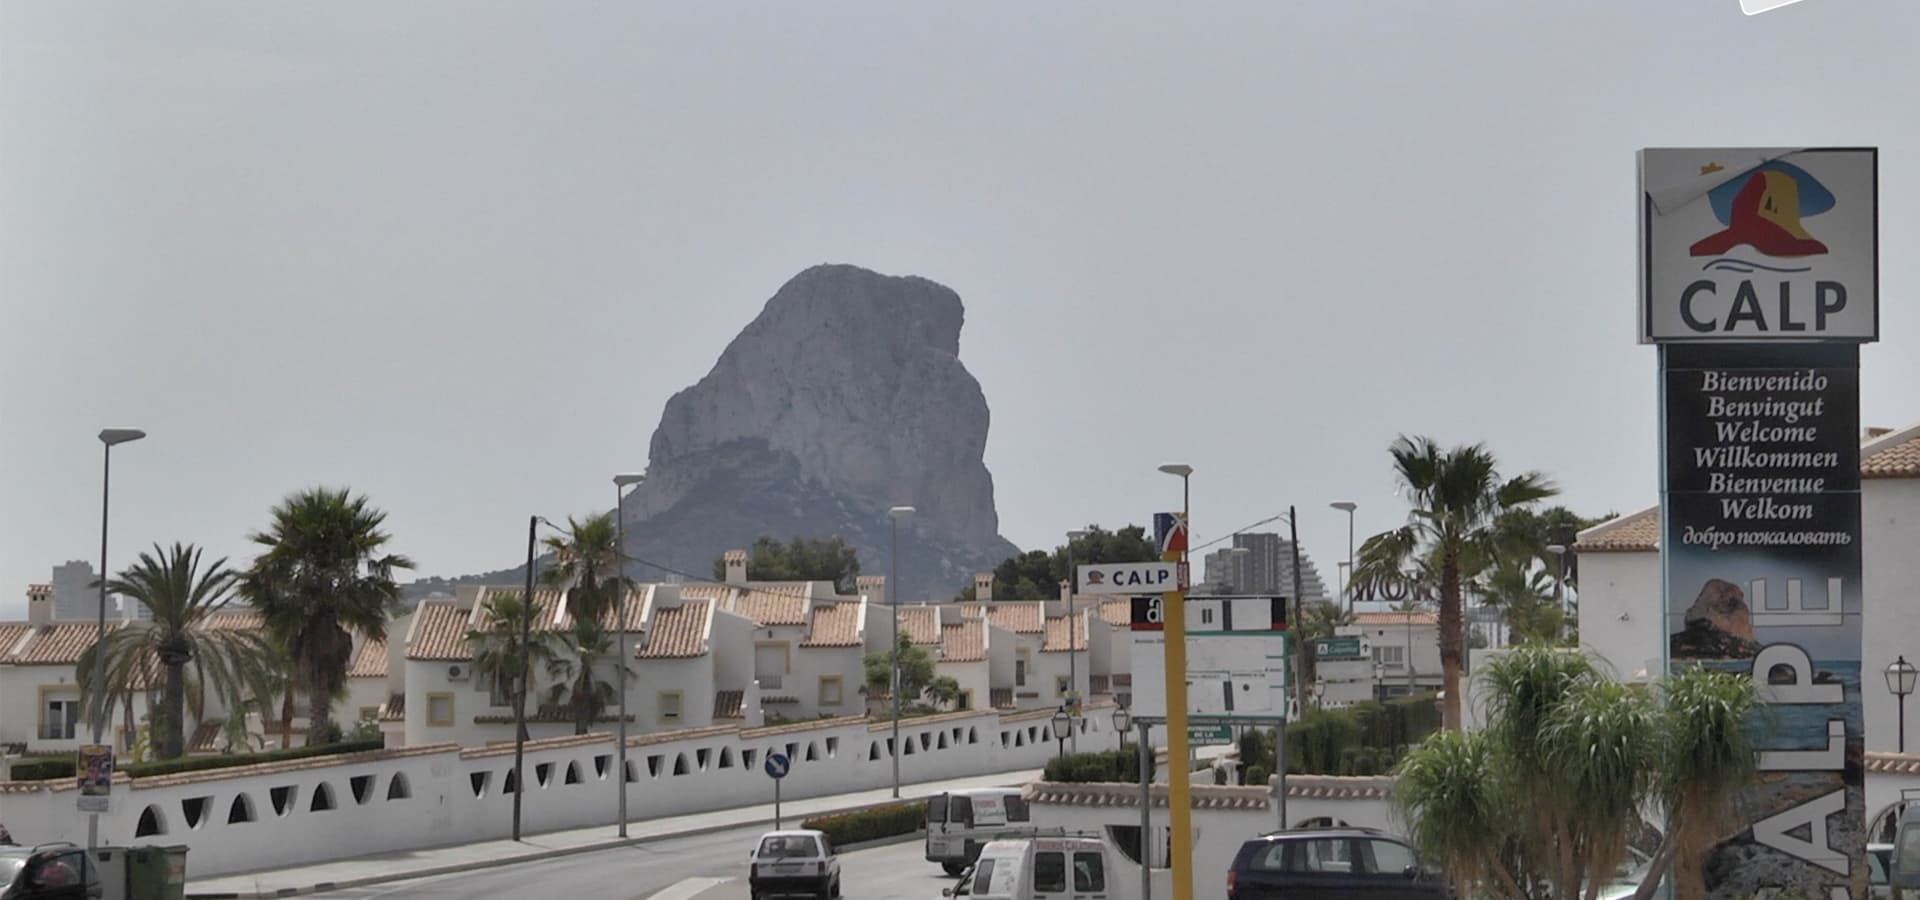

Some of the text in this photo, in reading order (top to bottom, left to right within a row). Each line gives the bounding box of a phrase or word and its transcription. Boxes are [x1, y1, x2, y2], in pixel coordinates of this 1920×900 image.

[1679, 279, 1847, 333] CALP
[1701, 369, 1828, 392] Bienvenido
[1706, 396, 1824, 423] Benvingut
[1715, 420, 1817, 442] Welcome
[1693, 446, 1838, 468] Willkommen
[1707, 473, 1825, 494] Bienvenue
[1720, 497, 1813, 519] Welkom
[1682, 526, 1852, 550] добро пожаловать
[1112, 569, 1169, 586] CALP
[1751, 577, 1850, 900] ALPE
